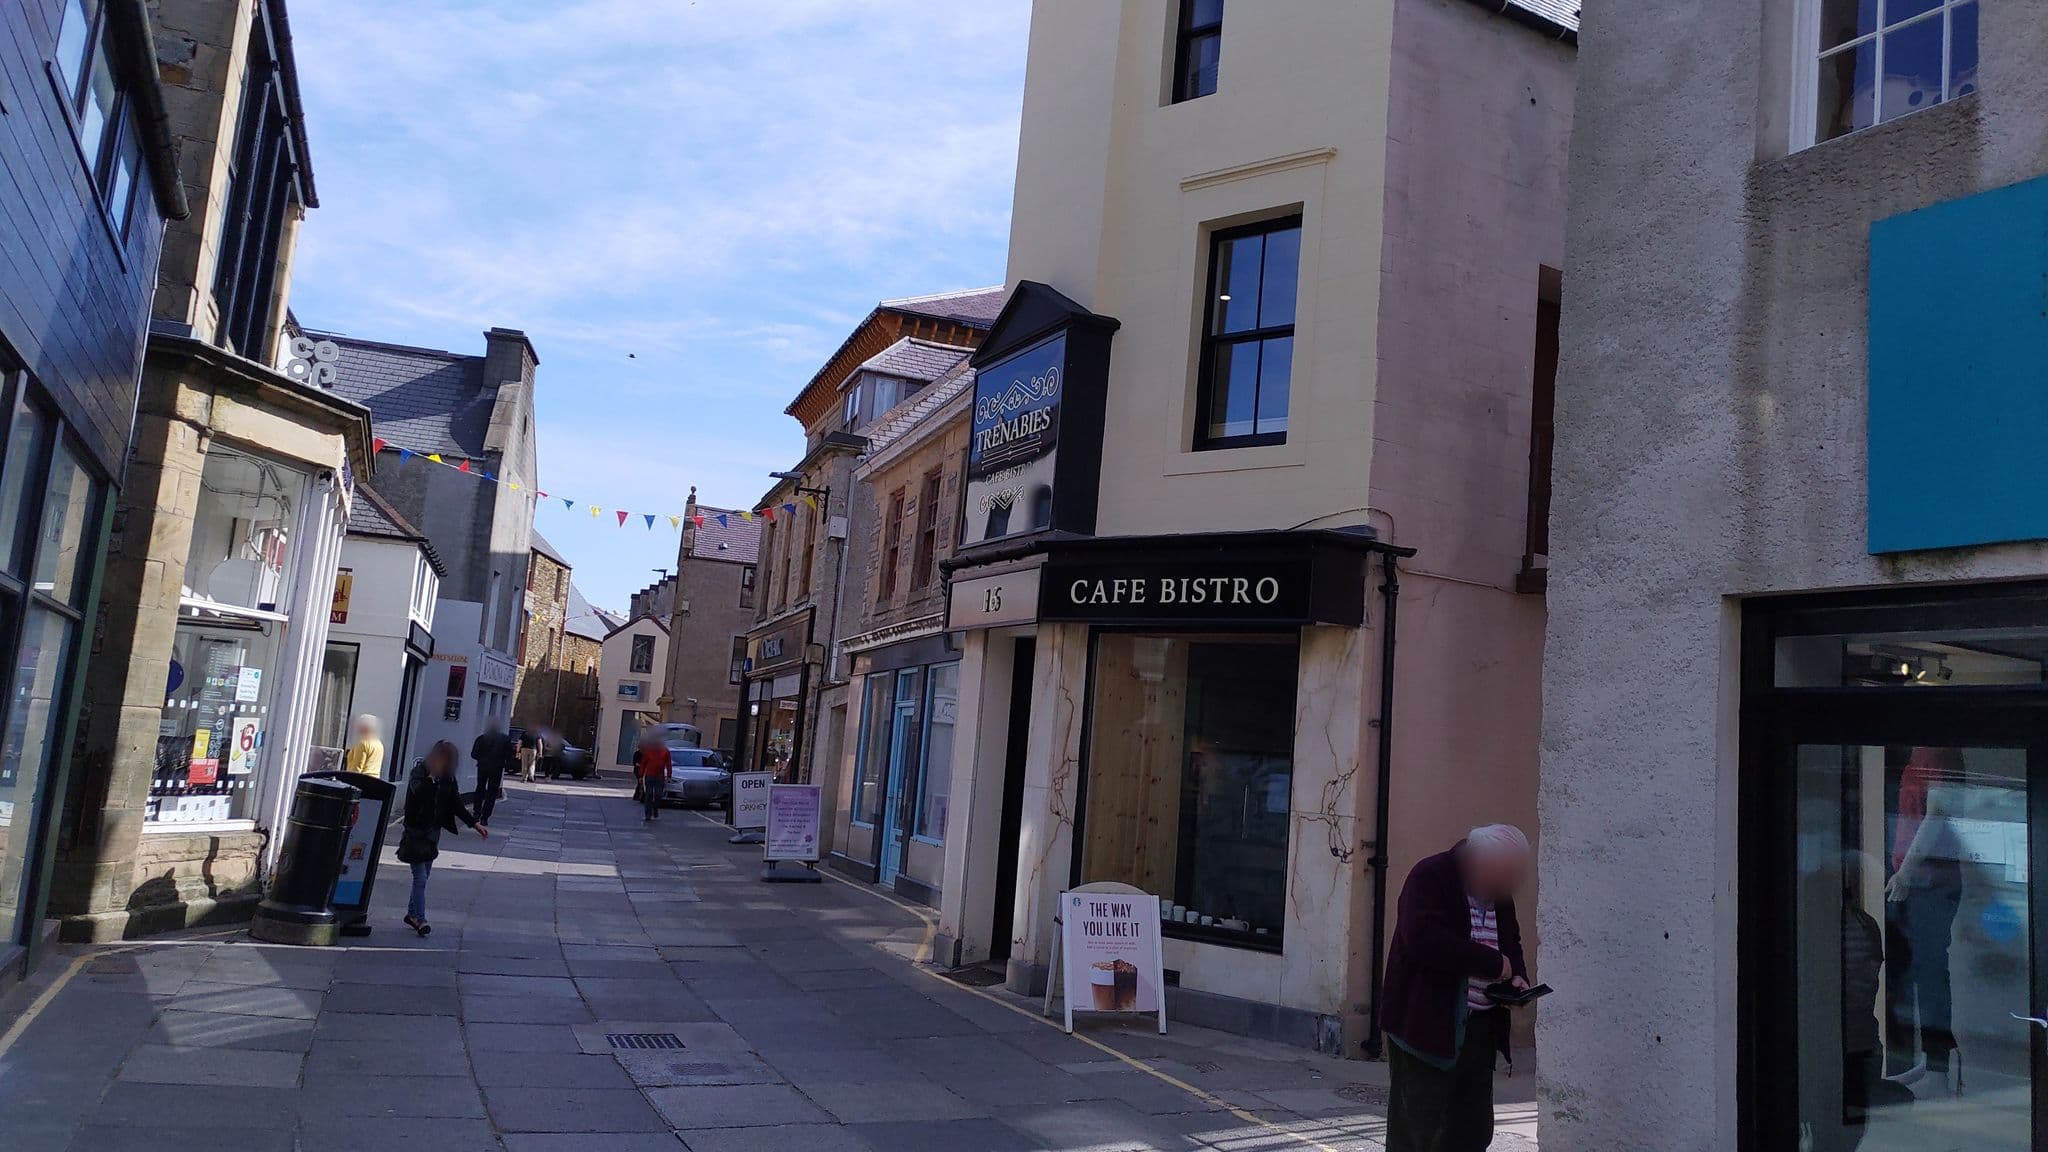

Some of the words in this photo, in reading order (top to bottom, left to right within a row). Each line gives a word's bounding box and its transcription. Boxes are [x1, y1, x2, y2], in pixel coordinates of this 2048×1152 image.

[975, 406, 1052, 453] TRENABIES
[983, 586, 1003, 613] 15
[1069, 578, 1147, 605] CAFE
[1159, 576, 1280, 605] BISTRO
[741, 779, 766, 789] OPEN
[1089, 902, 1108, 917] THE
[1110, 902, 1132, 918] WAY
[1082, 921, 1103, 937] YOU
[1106, 921, 1128, 937] LIKE
[1130, 922, 1140, 938] IT
